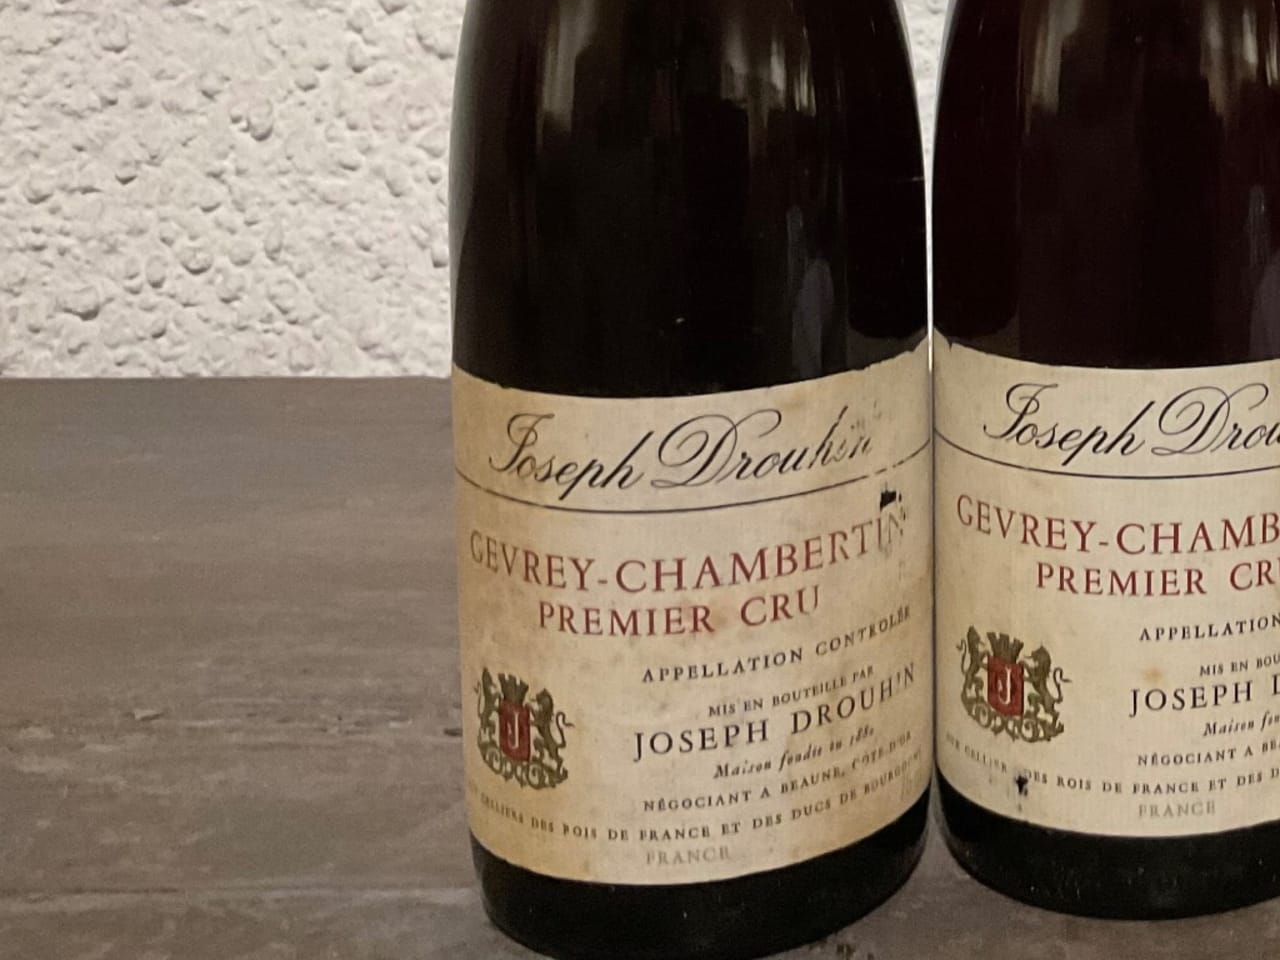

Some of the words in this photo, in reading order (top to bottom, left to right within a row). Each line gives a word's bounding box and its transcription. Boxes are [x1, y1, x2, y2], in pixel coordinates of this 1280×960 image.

[983, 382, 1155, 467] Joseph
[488, 412, 655, 501] Joseph
[1036, 561, 1206, 597] PREMIER
[538, 600, 717, 637] PREMIER
[740, 585, 821, 628] CRU
[641, 647, 804, 683] APPELLATION
[1200, 664, 1224, 677] MIS
[1230, 658, 1249, 673] EN
[708, 703, 736, 718] MIS
[743, 697, 764, 712] EN
[772, 675, 847, 708] BOUTEILLE
[1129, 679, 1253, 718] JOSEPH
[633, 718, 769, 762] JOSEPH
[1202, 718, 1256, 738] Maison
[713, 757, 772, 779] Maison
[1056, 774, 1093, 792] ROIS
[1102, 781, 1123, 794] DE
[1132, 781, 1200, 795] FRANCE
[1208, 778, 1228, 792] ET
[1236, 771, 1264, 788] DES
[608, 828, 629, 841] DE
[639, 826, 711, 842] FRANCE
[721, 821, 742, 836] ET
[752, 813, 783, 831] DES
[791, 800, 832, 821] DUCS
[839, 790, 858, 806] DE
